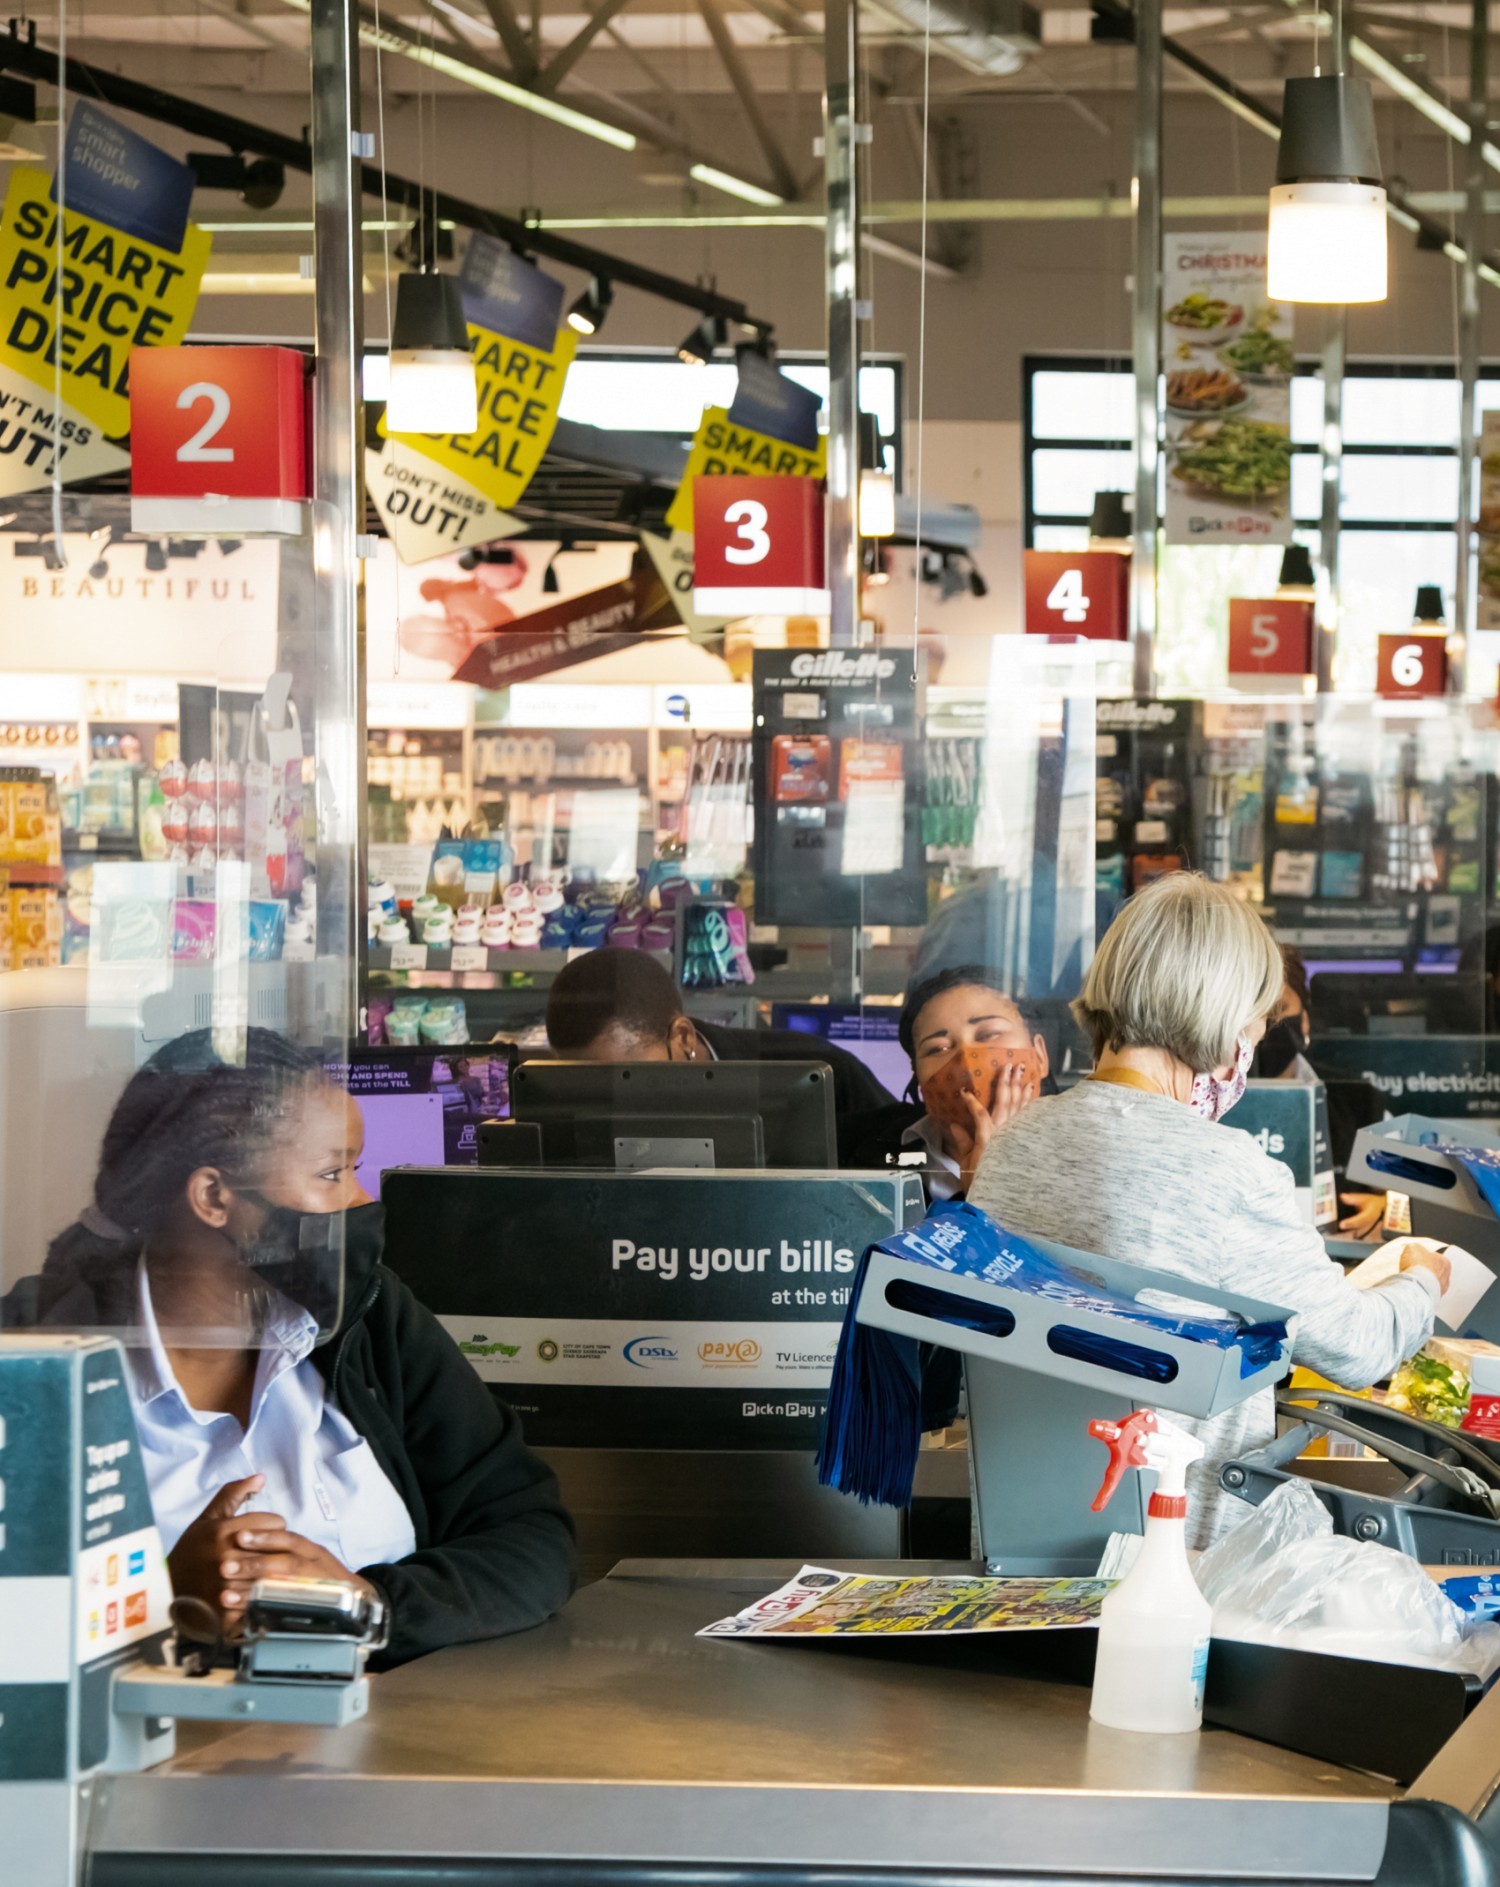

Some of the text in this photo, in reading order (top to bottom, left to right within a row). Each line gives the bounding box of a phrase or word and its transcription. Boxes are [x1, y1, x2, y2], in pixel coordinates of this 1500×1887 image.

[78, 127, 127, 166] smart
[72, 145, 140, 190] shopper
[13, 201, 185, 299] SMART
[5, 248, 173, 347] PRICE
[32, 408, 92, 446] MISS
[175, 382, 235, 462] 2
[476, 379, 548, 436] ICE
[0, 418, 68, 476] UT!
[383, 461, 487, 516] DON'T MISS
[386, 488, 468, 542] OUT!
[724, 499, 771, 565] 3
[22, 576, 256, 600] BEAUTIFUL
[1047, 570, 1090, 622] 4
[1250, 614, 1280, 658] 5
[790, 651, 897, 679] Gillette
[1391, 645, 1423, 686] 6
[352, 1072, 373, 1080] AND
[374, 1072, 408, 1080] SPEND
[354, 1064, 371, 1072] you
[612, 1239, 855, 1281] Pay your bills
[771, 1288, 852, 1305] at the til
[458, 1341, 521, 1357] EasyPay
[639, 1347, 679, 1357] DStv
[776, 1352, 791, 1362] TV
[743, 1403, 774, 1417] Pick
[775, 1405, 784, 1415] n
[785, 1403, 816, 1418] Pay
